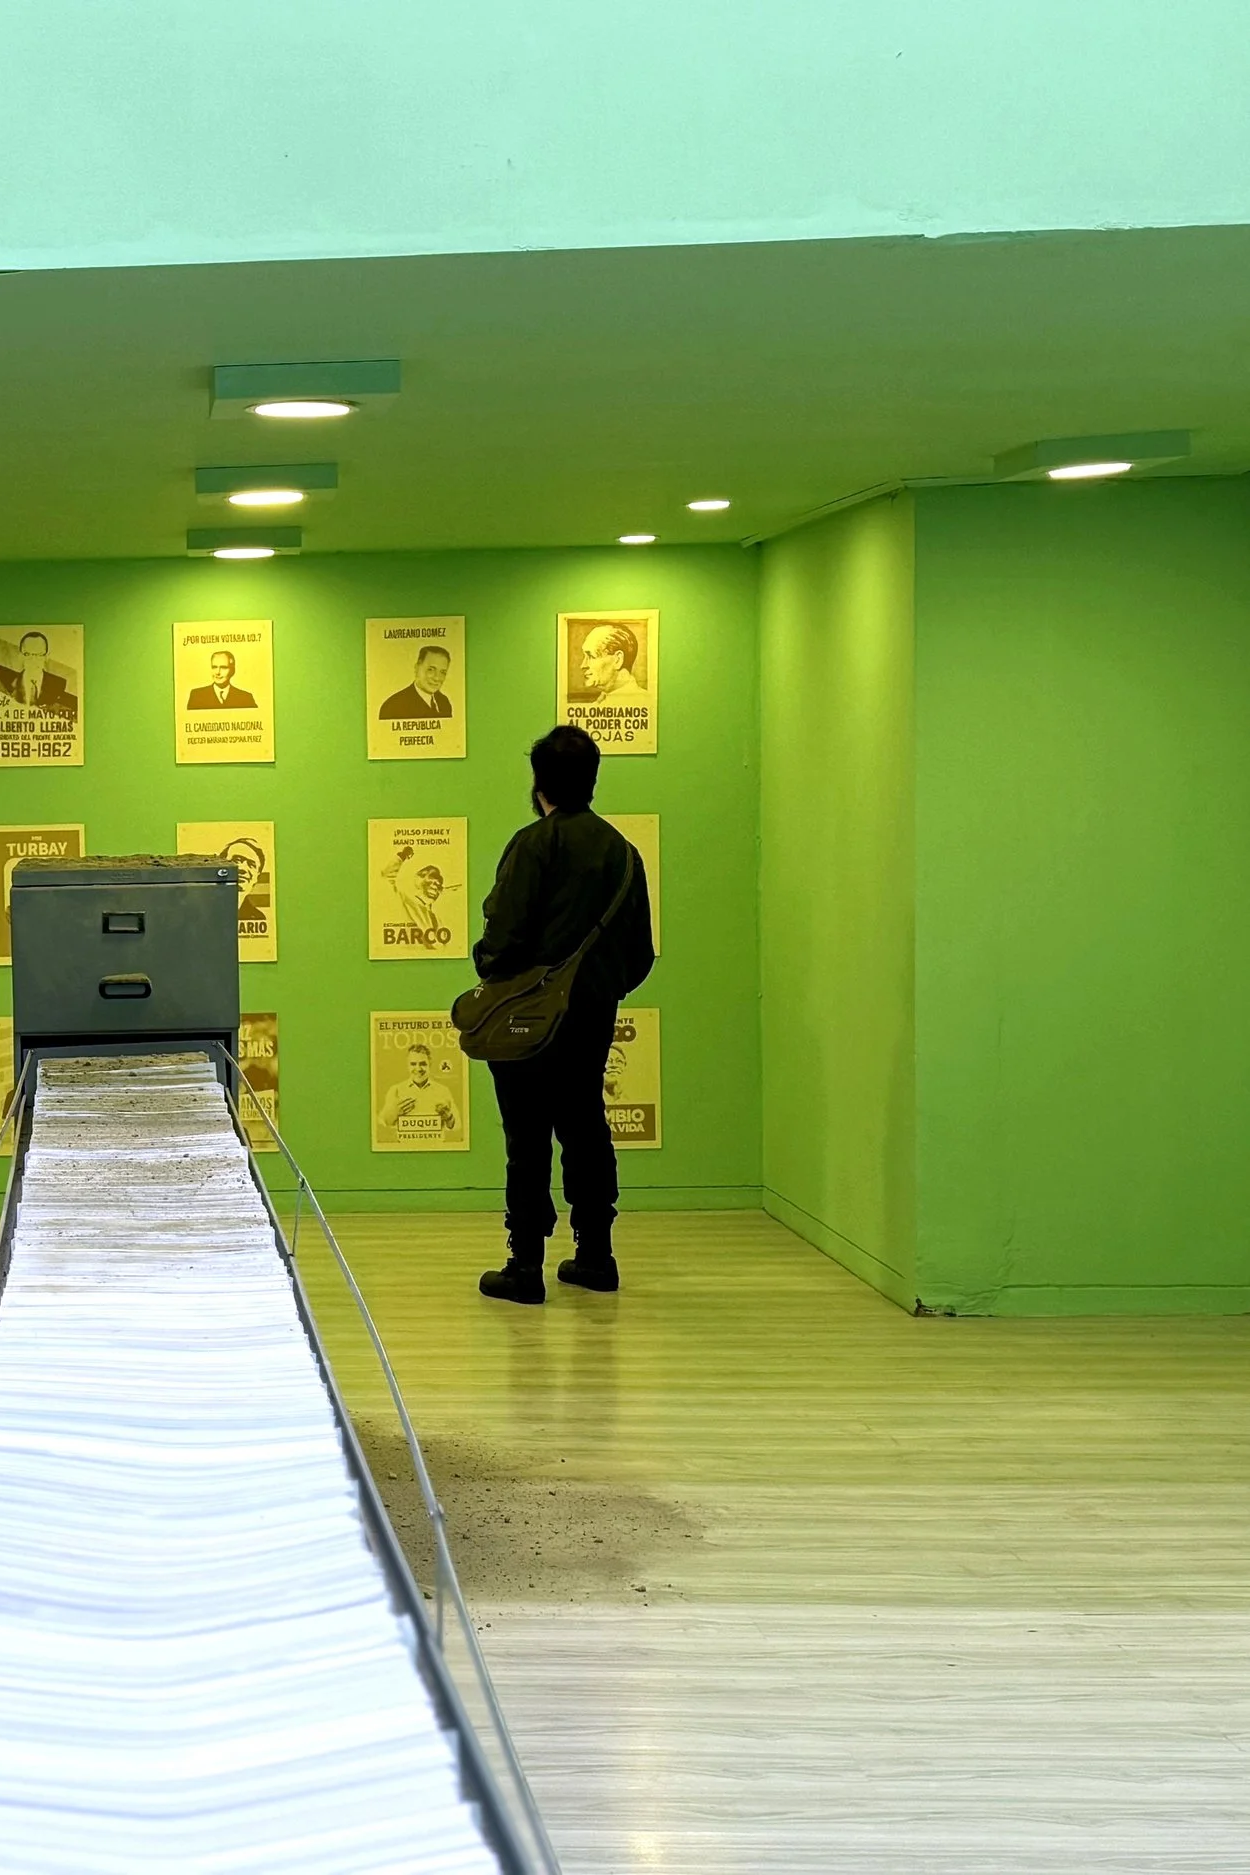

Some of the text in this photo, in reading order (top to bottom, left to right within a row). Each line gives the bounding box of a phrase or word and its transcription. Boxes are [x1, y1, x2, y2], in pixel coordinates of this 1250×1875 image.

[384, 627, 446, 639] LAUREANO GOMEZ
[3, 708, 10, 719] 4
[13, 709, 25, 719] DE
[28, 709, 55, 719] MAYO
[567, 707, 649, 718] COLOMBIANOS
[40, 721, 74, 733] LLERAS
[185, 721, 264, 732] EL CANDIDATO NACIONAL
[392, 720, 441, 731] LA REPUBLICA
[585, 719, 621, 730] PODER
[624, 719, 649, 730] CON
[399, 736, 434, 746] PERFECTA
[590, 731, 635, 742] OJAS
[6, 842, 68, 856] TURBAY
[238, 921, 268, 934] ARIO
[383, 927, 452, 945] BARCO
[379, 1021, 454, 1030] EL FUTURO ES D
[379, 1030, 459, 1049] TODOS
[605, 1108, 645, 1123] MBIO
[401, 1119, 439, 1128] DUQUE
[616, 1123, 645, 1133] VIDA
